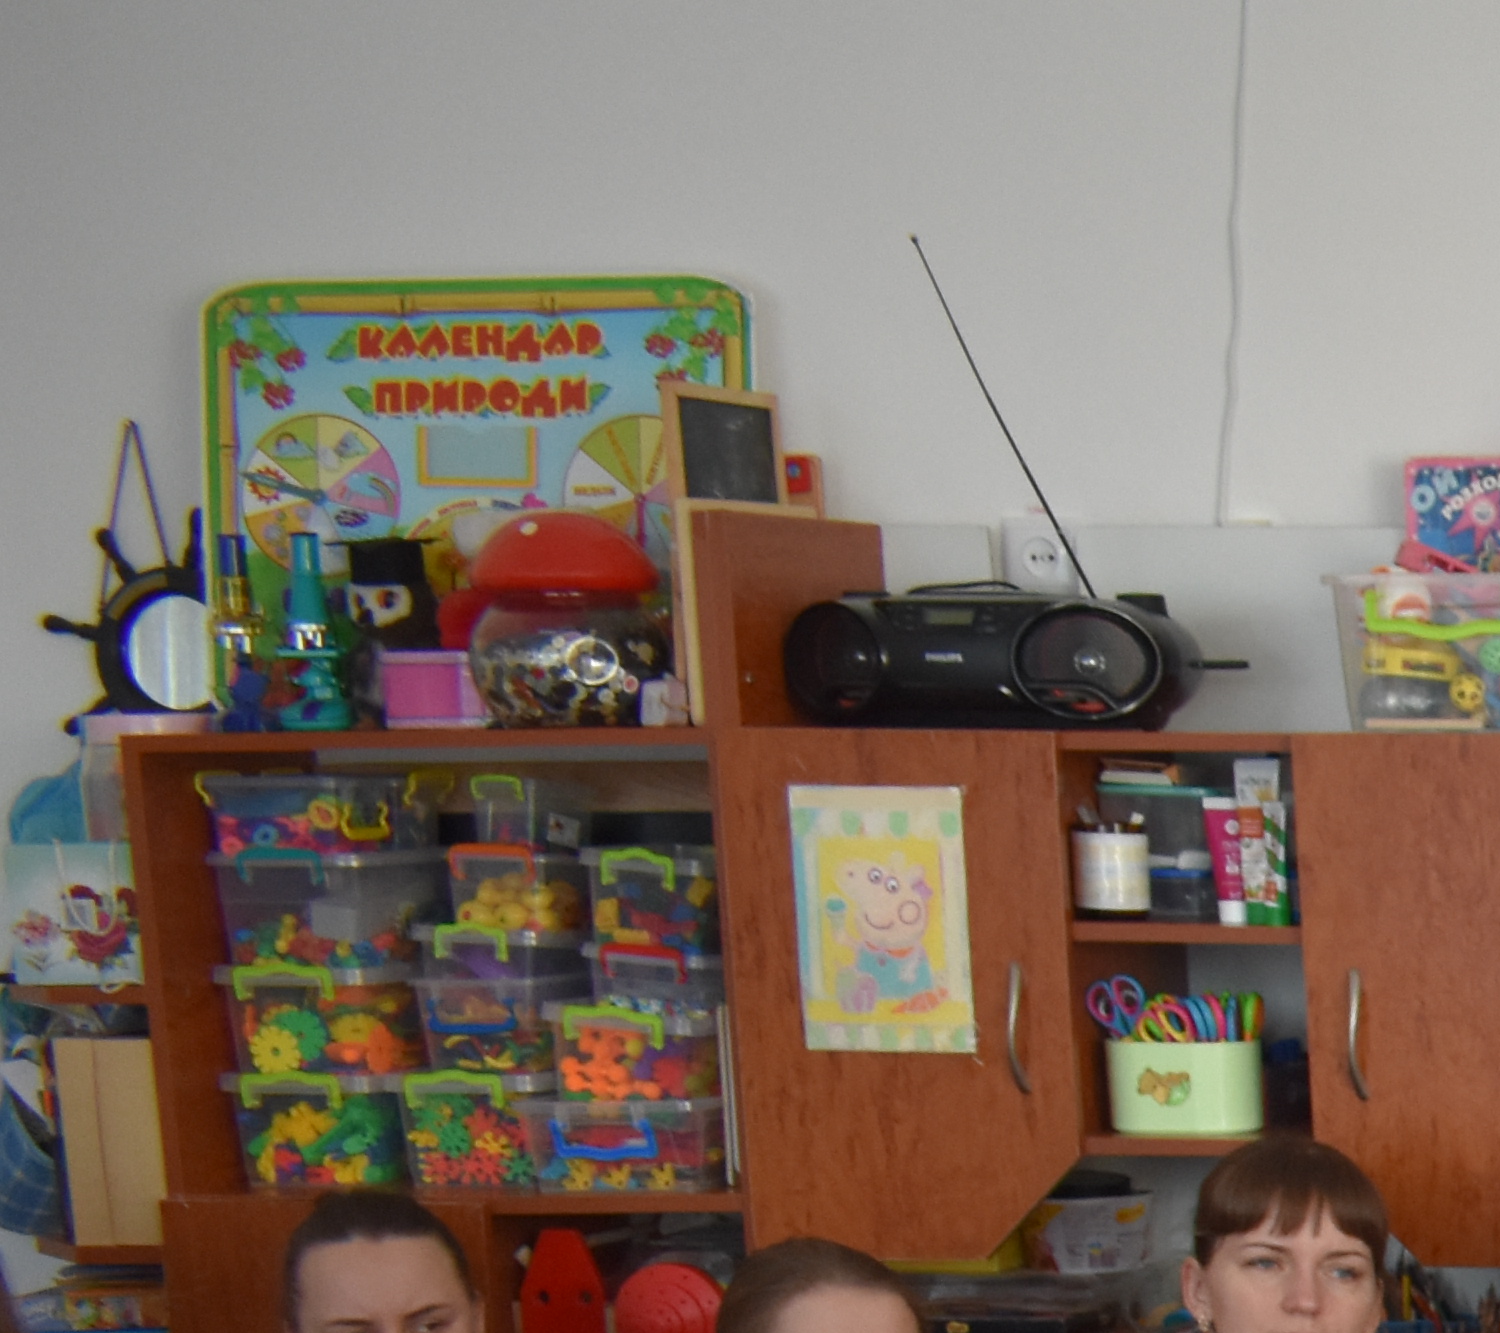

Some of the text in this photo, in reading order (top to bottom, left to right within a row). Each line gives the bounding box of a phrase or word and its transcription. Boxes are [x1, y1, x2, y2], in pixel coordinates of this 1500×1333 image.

[356, 319, 604, 363] КАЛЕНДАР
[373, 373, 589, 418] ПРИРОДИ
[1411, 467, 1458, 512] ОЙ
